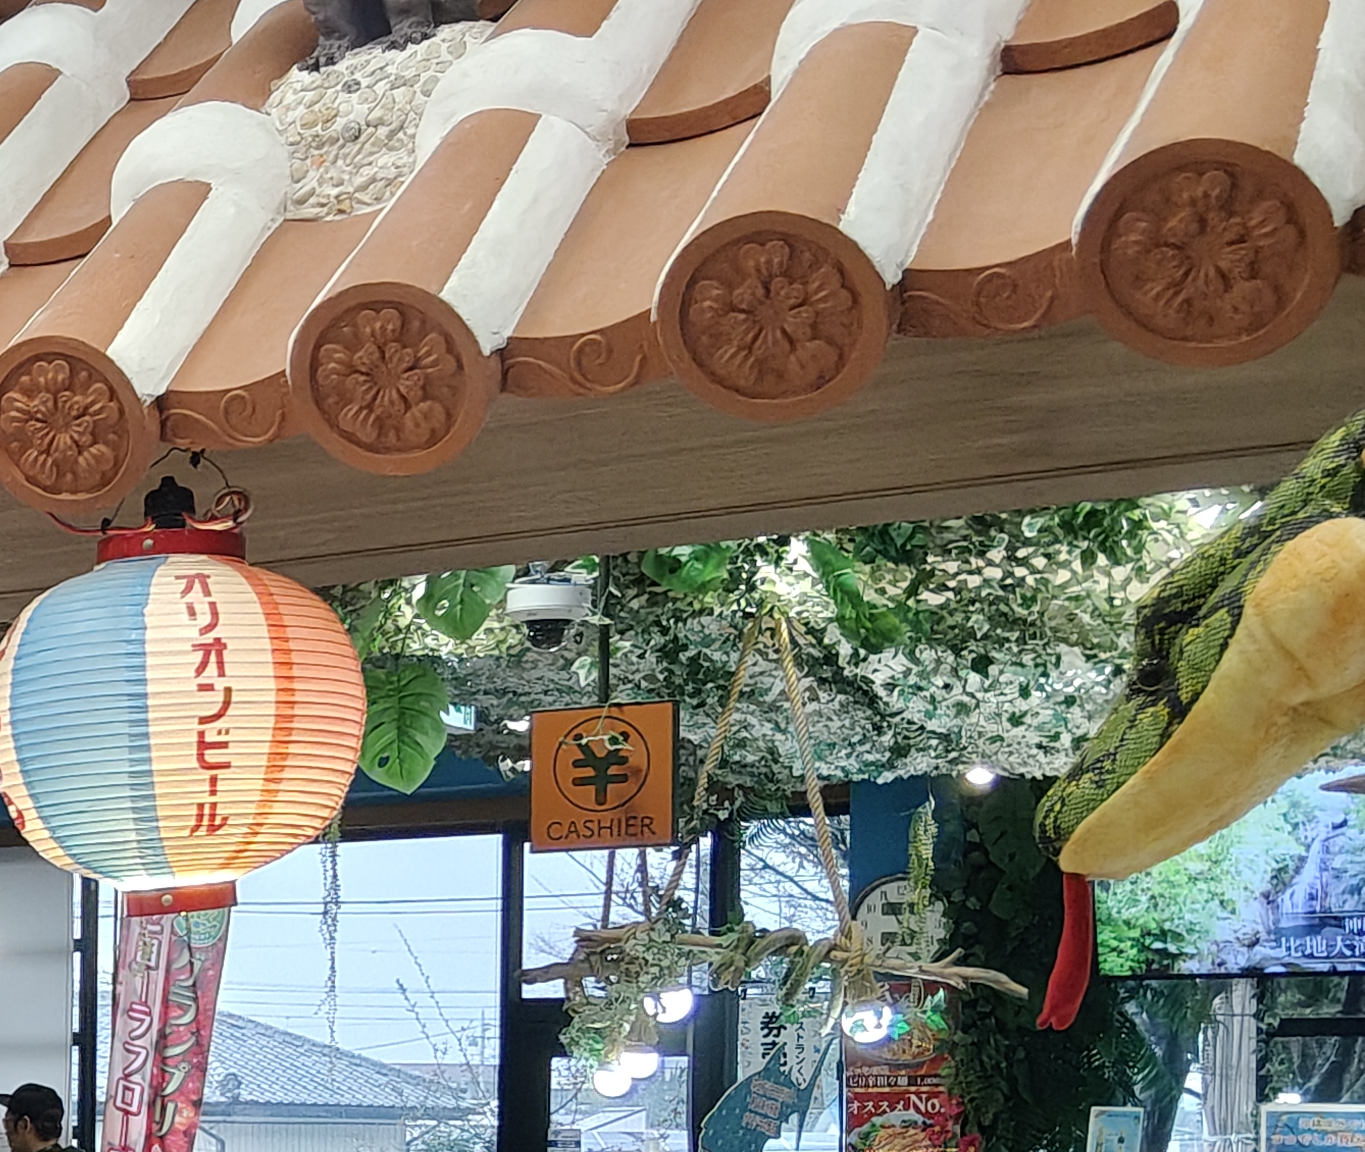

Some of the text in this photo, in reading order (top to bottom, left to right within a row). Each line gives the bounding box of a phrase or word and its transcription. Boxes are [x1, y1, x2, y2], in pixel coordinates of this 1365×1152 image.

[173, 572, 235, 838] オリオンビール
[545, 815, 658, 843] CASHIER
[847, 1100, 903, 1117] オススメ
